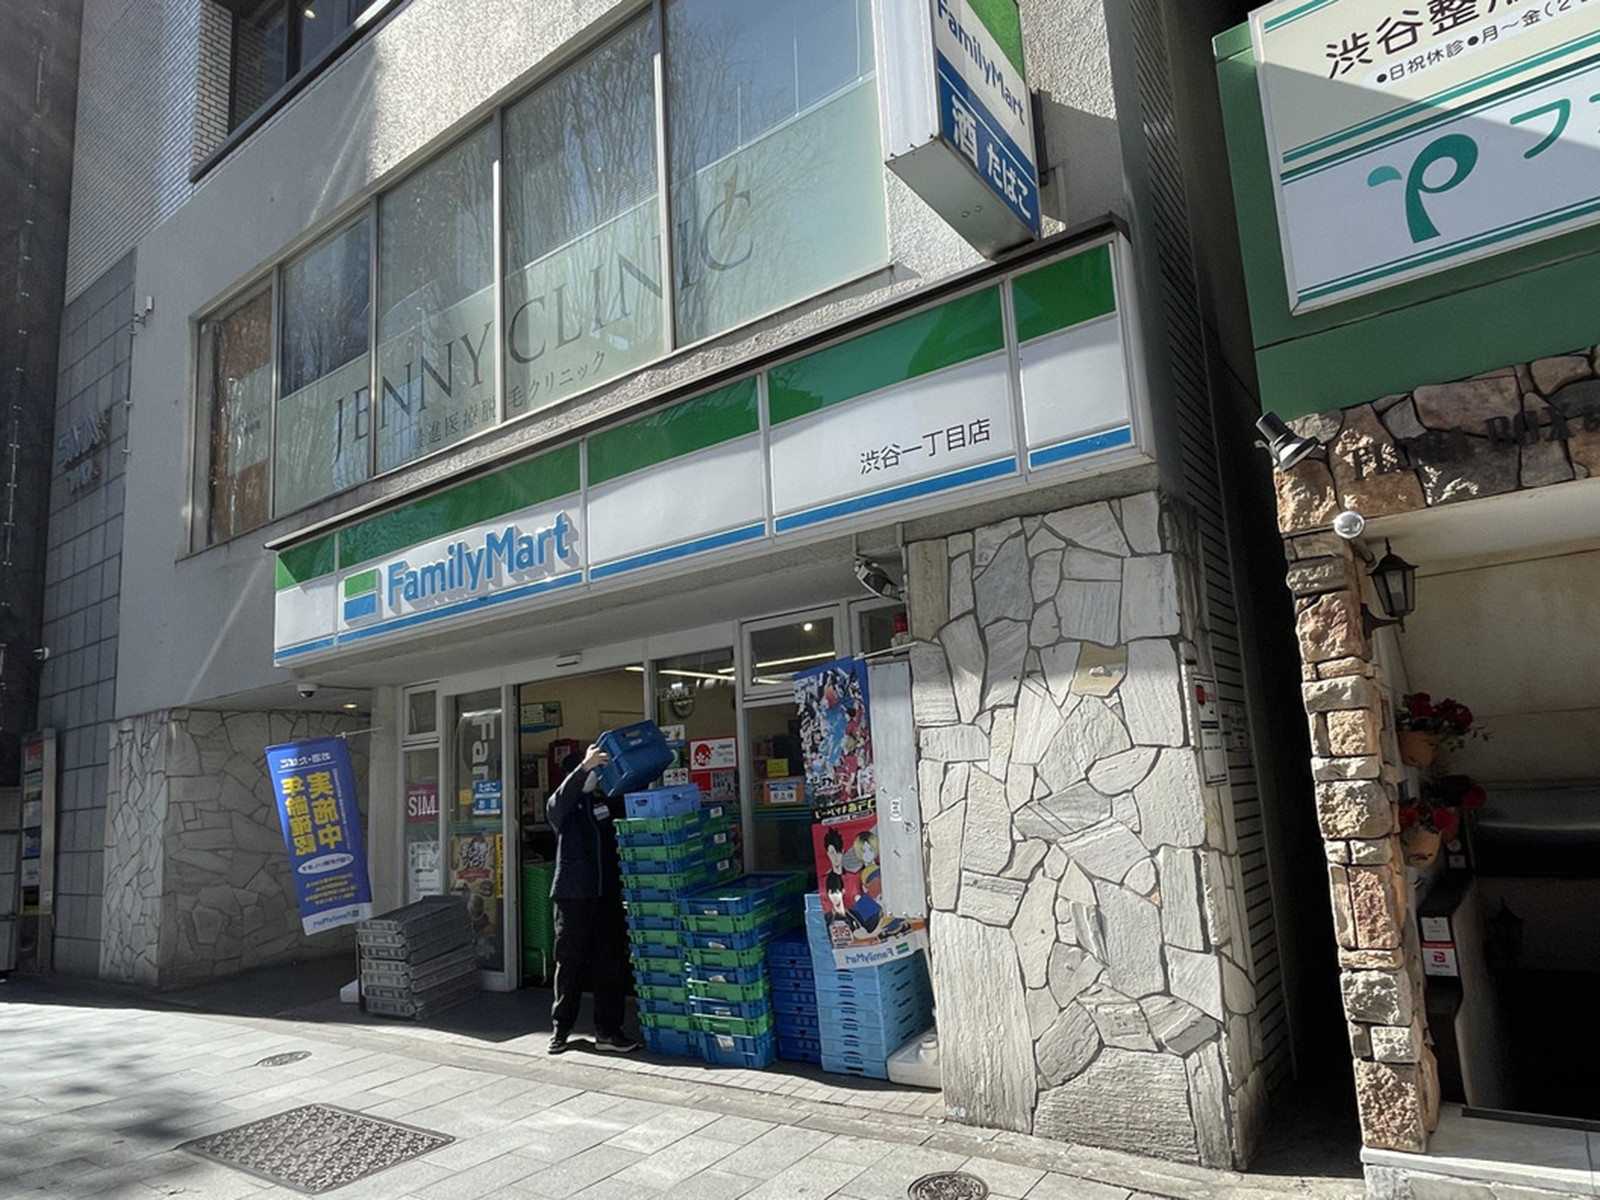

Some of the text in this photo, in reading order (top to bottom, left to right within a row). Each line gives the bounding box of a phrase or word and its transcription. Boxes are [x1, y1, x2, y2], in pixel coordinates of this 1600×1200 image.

[937, 0, 1026, 126] FamilyMart
[1325, 0, 1522, 79] 渋谷整
[951, 93, 1032, 220] 酒 たばこ
[331, 189, 754, 468] JENNY CLINIC
[860, 418, 990, 475] 渋谷一丁目店
[388, 511, 570, 607] FamilyMart
[408, 794, 436, 817] SIM
